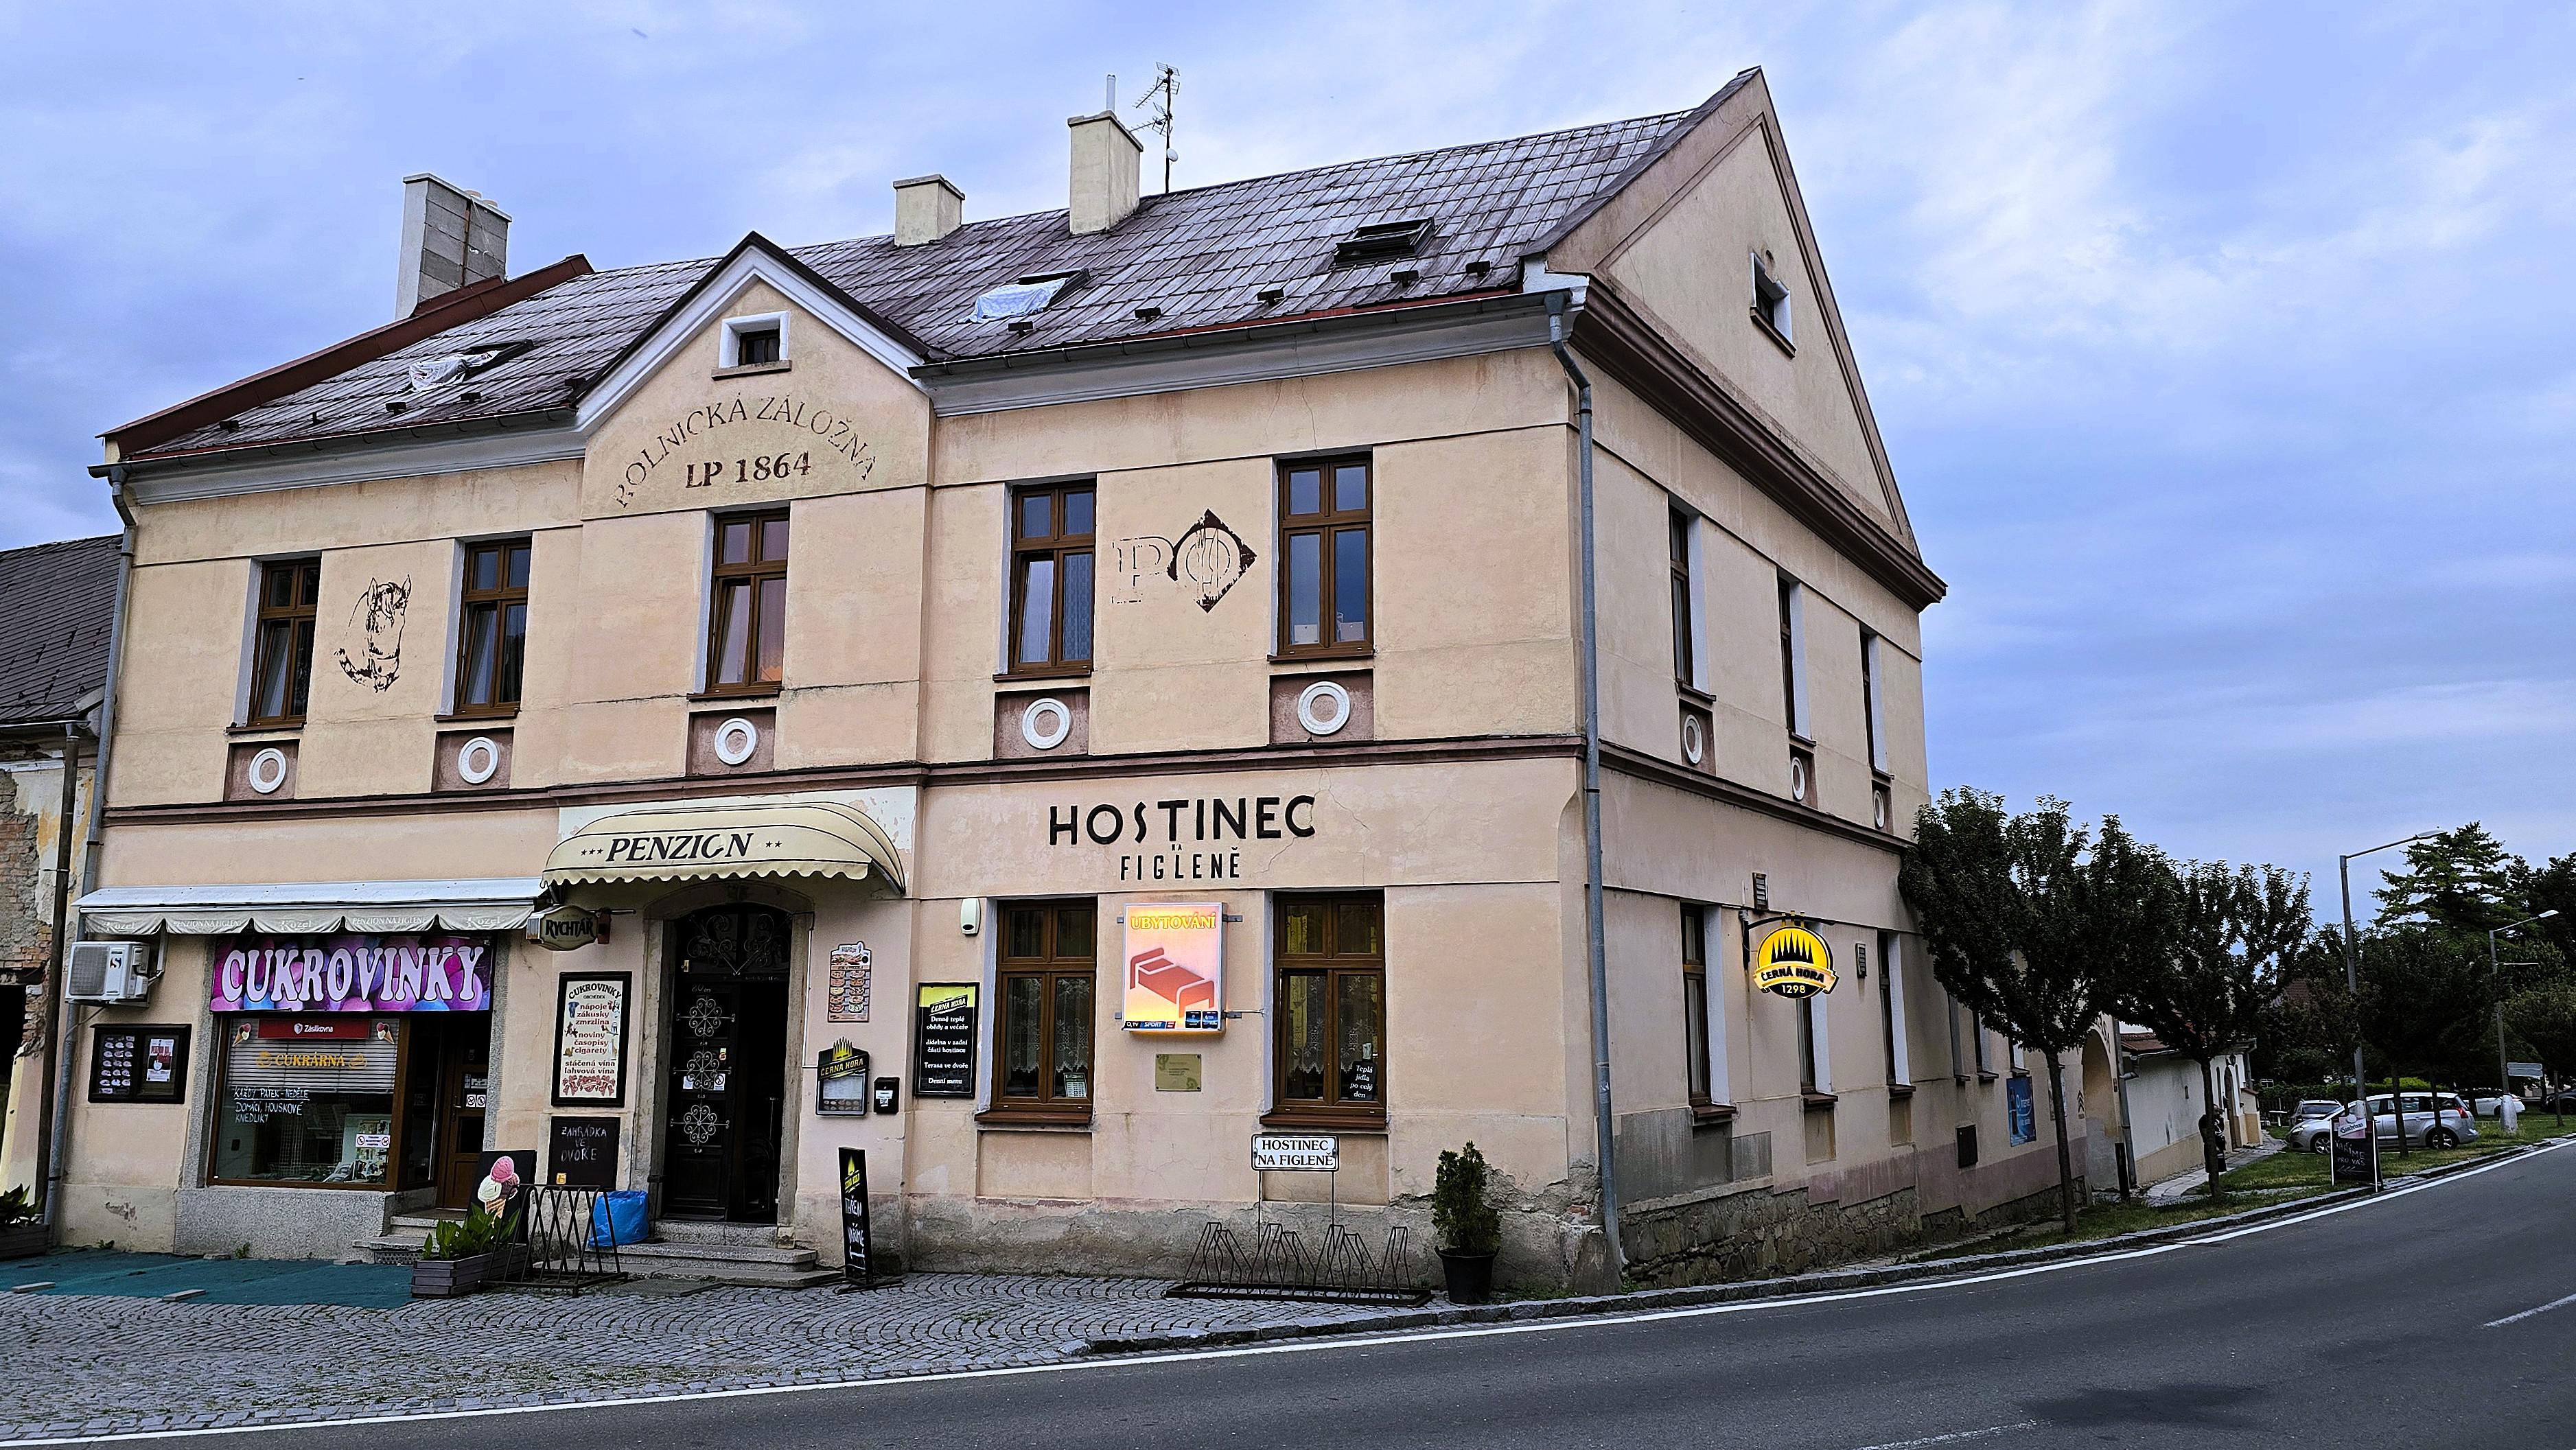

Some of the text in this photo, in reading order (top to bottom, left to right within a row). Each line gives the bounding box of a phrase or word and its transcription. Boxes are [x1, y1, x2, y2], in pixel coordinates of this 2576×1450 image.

[611, 392, 877, 508] ROLNICKÁ ZÁLOŽNA
[686, 450, 811, 488] LP 1864
[1049, 794, 1316, 845] HOSTINEC
[605, 832, 754, 863] PENZION
[1171, 843, 1183, 852] NA
[1120, 846, 1240, 881] FIGLENĚ
[1131, 912, 1216, 929] UBYTOVÁNÍ
[546, 917, 596, 939] RYCHTÁŘ
[222, 946, 484, 1002] CUKROVINKY
[1761, 966, 1824, 983] ČERNÁ HORA
[568, 983, 622, 1000] CUKROVINKY
[1782, 984, 1806, 994] 1298
[579, 1003, 607, 1011] nápoje
[951, 998, 966, 1008] HORA
[577, 1011, 610, 1019] zákusky
[304, 1024, 334, 1033] Zásilkovna
[575, 1046, 607, 1055] cigarety
[275, 1051, 345, 1067] CUKRÁRNA
[845, 1058, 863, 1069] HORA
[1356, 1064, 1373, 1073] Teplá
[286, 1086, 308, 1098] NEDĚLE
[1359, 1084, 1373, 1092] celý
[264, 1101, 303, 1116] HOUSKOVÉ
[561, 1124, 607, 1138] ZAHRÁDKA
[575, 1137, 586, 1147] VE
[1262, 1140, 1329, 1151] HOSTINEC
[1257, 1152, 1334, 1166] NA FIGLENĚ
[2351, 1158, 2366, 1166] VÁS
